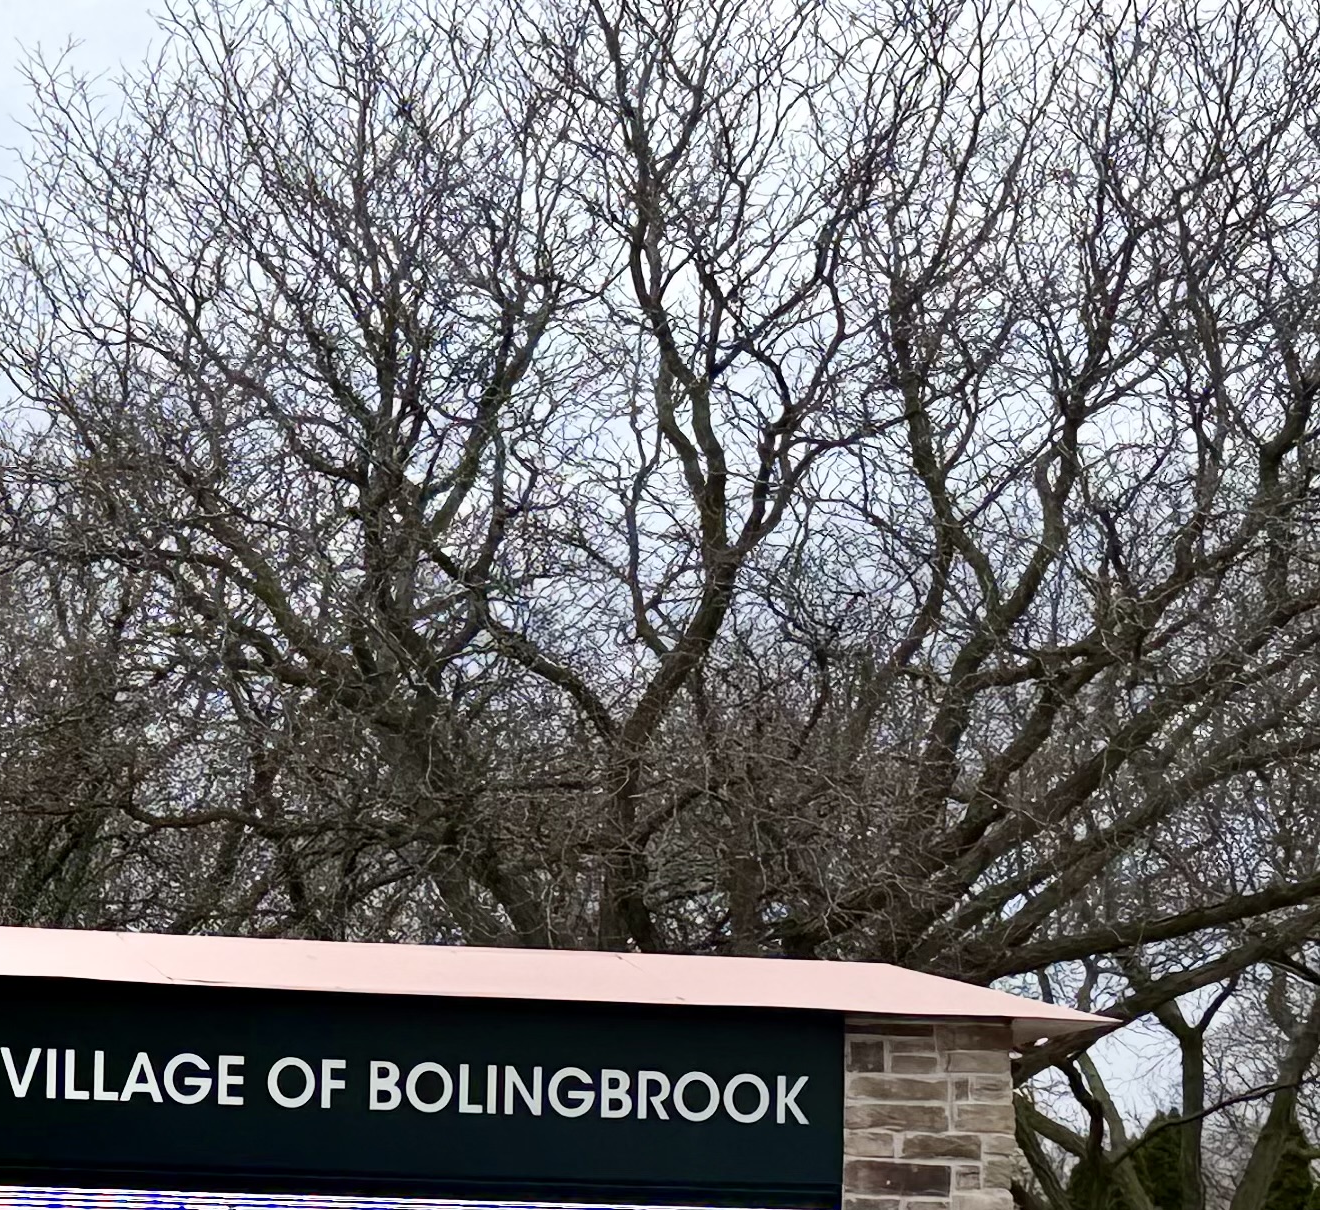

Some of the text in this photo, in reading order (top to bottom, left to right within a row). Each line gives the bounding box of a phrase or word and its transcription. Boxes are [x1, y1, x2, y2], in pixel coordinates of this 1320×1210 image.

[0, 1046, 810, 1127] VILLAGE OF BOLINGBROOK
